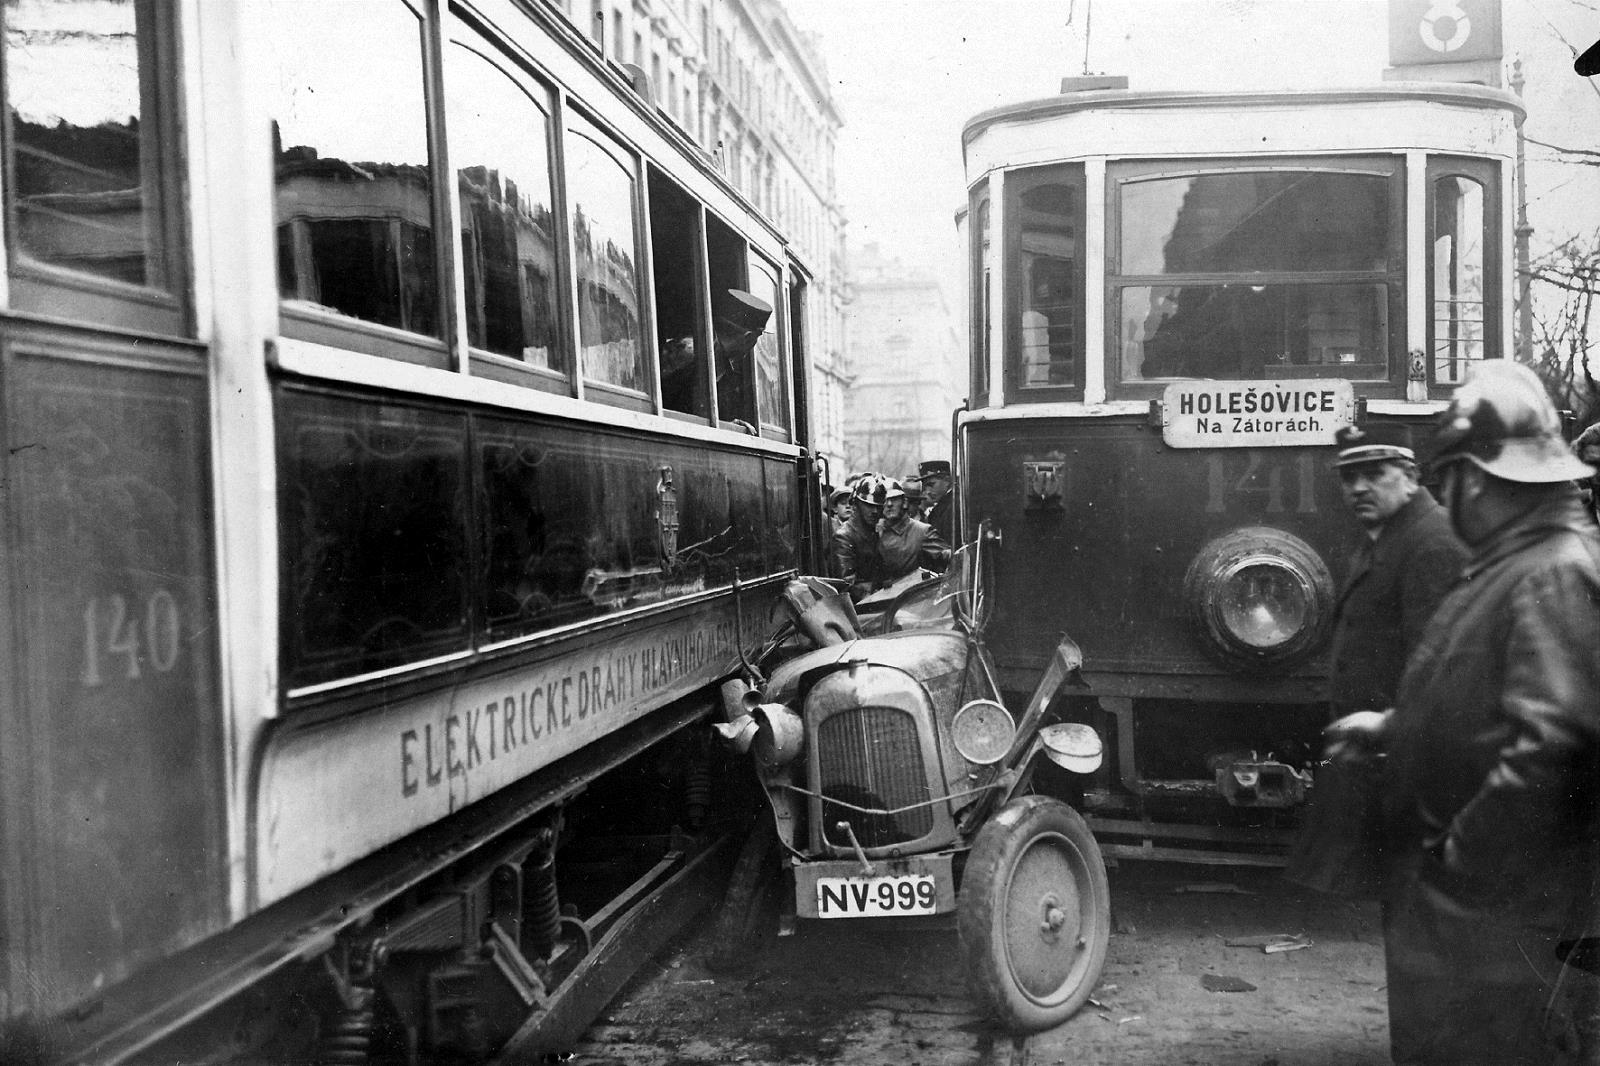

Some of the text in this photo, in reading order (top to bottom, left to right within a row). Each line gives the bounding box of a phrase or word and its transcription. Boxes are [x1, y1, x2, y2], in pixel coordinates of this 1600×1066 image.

[1180, 387, 1336, 415] HOLEŠOVICE
[1196, 418, 1222, 434] Na
[80, 588, 180, 687] 140
[821, 880, 936, 913] NV-999
